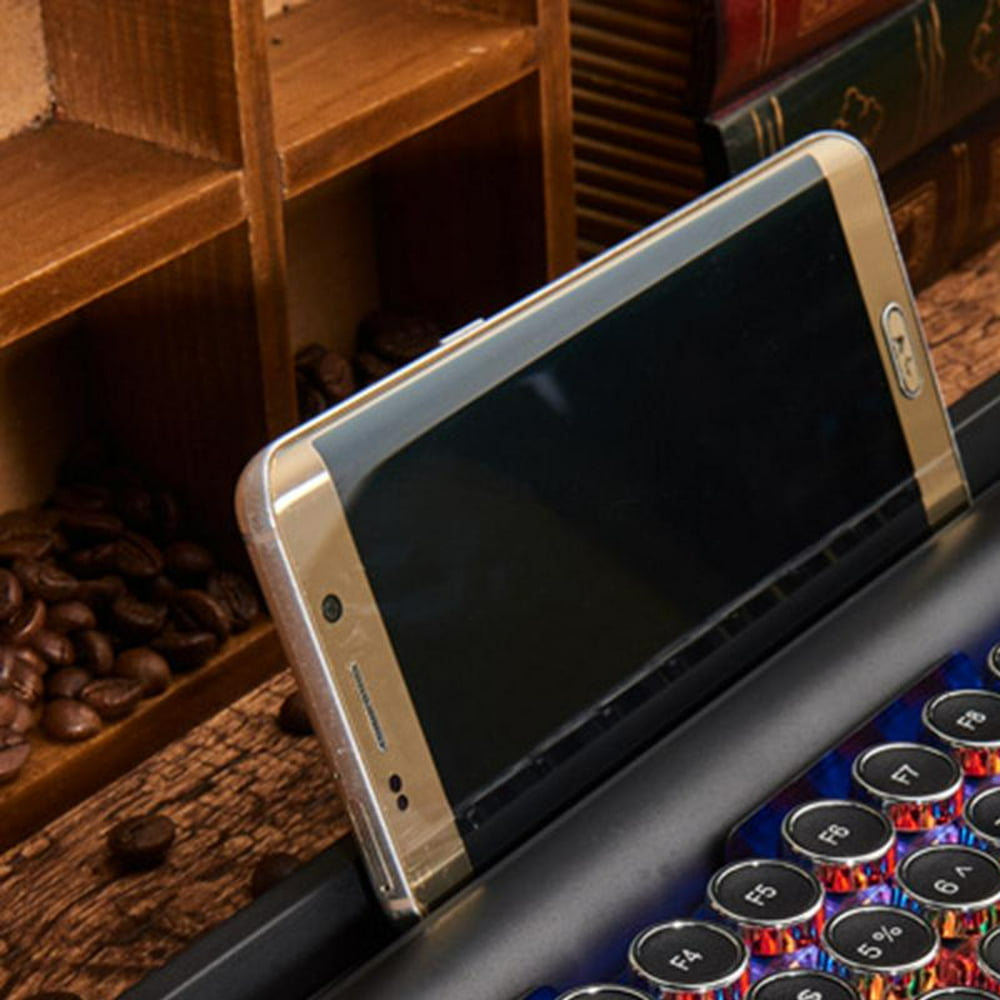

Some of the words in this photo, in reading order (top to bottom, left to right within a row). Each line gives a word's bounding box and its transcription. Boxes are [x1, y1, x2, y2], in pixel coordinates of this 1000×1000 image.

[956, 710, 987, 730] F8
[890, 763, 919, 785] F7
[818, 824, 850, 846] F6
[744, 883, 777, 906] F5
[933, 879, 959, 894] 6
[669, 949, 702, 971] F4
[857, 941, 883, 960] 5
